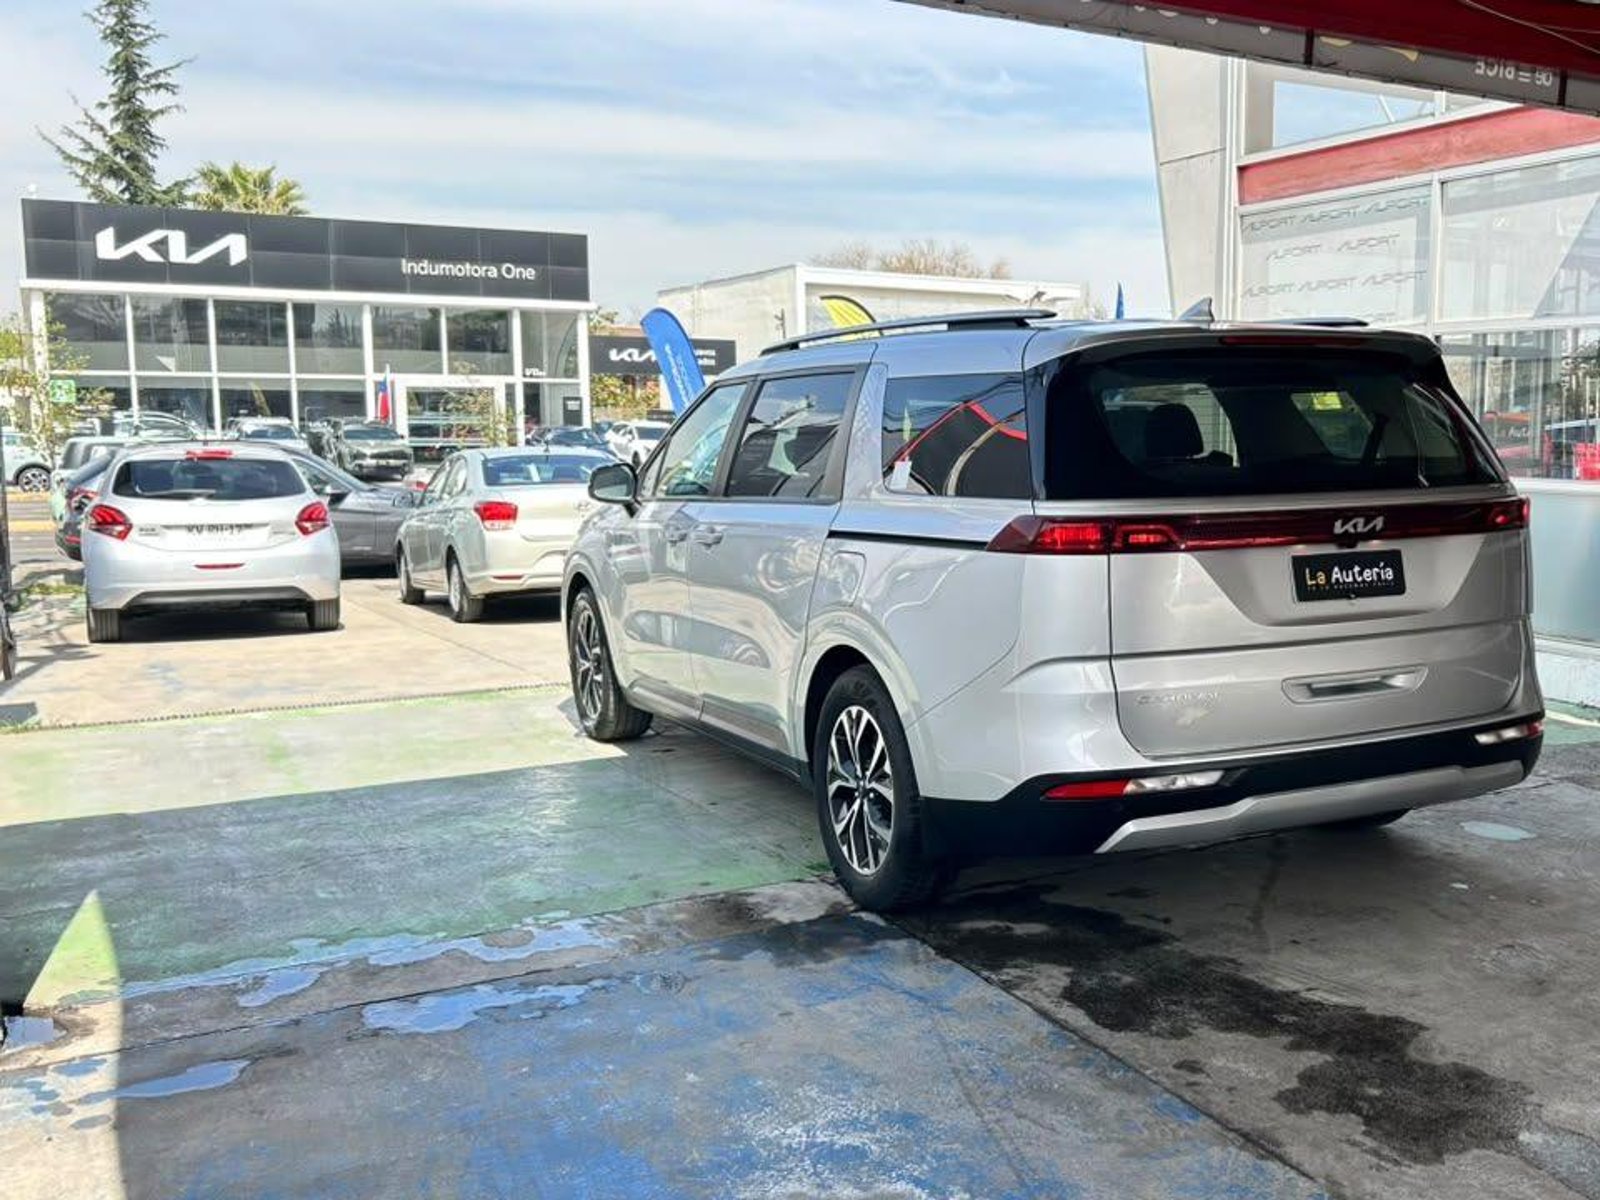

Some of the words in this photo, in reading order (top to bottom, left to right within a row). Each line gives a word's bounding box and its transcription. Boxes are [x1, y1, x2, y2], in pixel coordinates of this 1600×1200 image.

[95, 226, 248, 266] KIA
[401, 258, 498, 279] Indumotora
[501, 263, 536, 280] One
[608, 347, 657, 362] KIA
[1333, 516, 1384, 534] KIA
[1305, 567, 1327, 586] La
[1331, 562, 1394, 584] Autería
